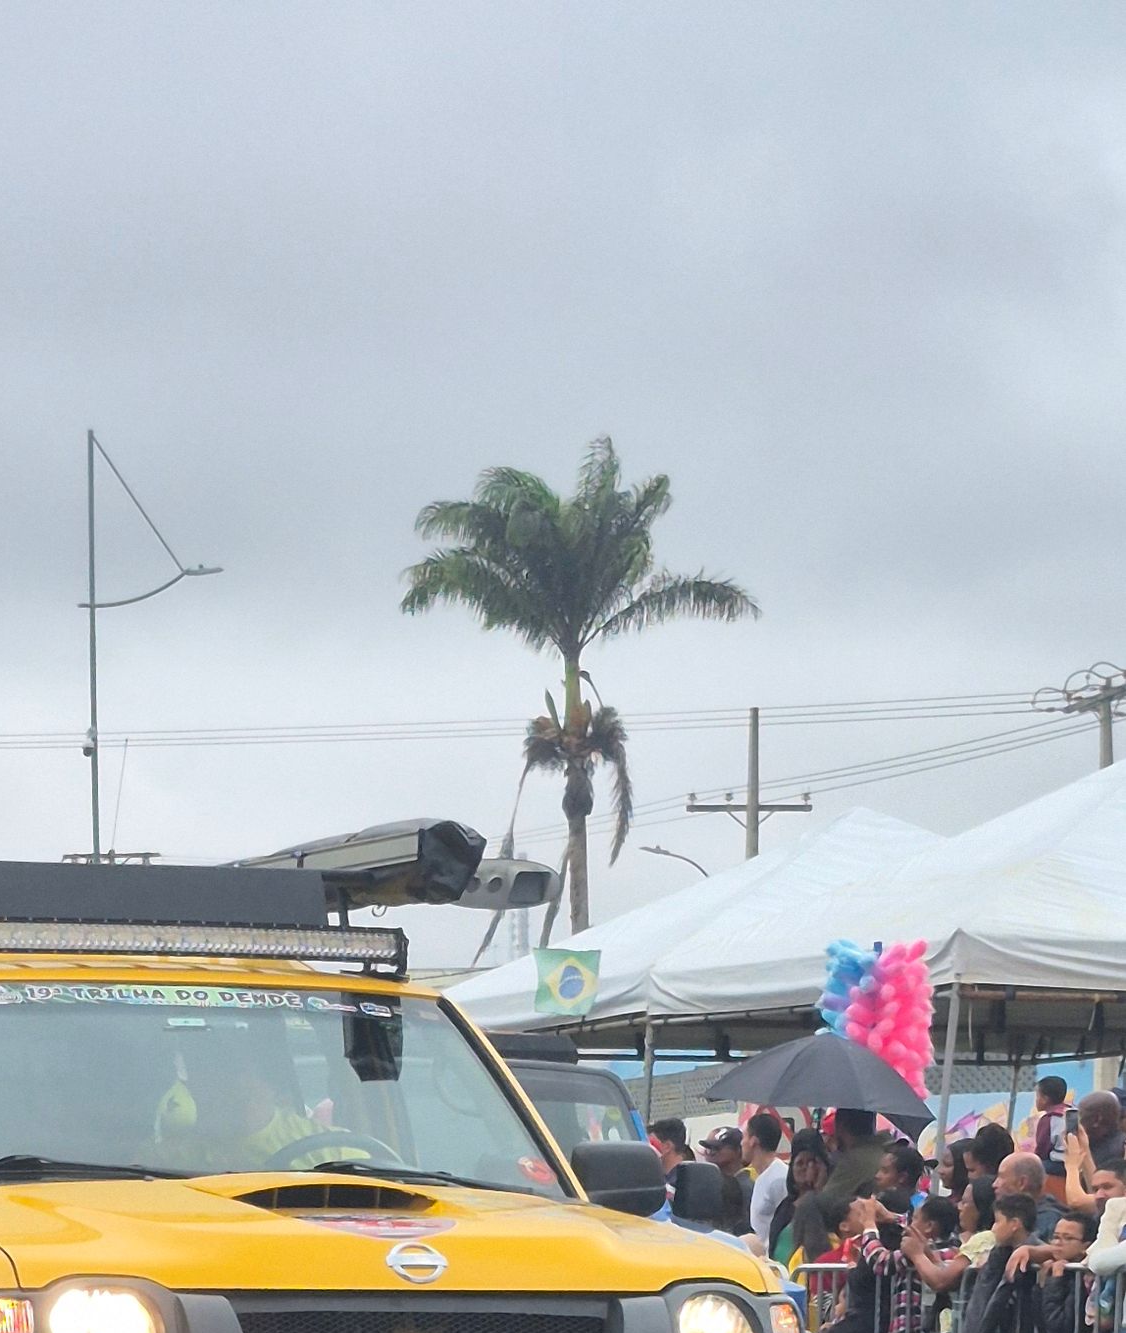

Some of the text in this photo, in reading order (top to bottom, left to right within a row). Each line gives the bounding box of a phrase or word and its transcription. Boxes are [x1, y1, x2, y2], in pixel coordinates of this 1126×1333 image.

[72, 986, 165, 1000] TRILHA
[175, 988, 209, 1001] DO
[218, 990, 303, 1008] DENDÊ
